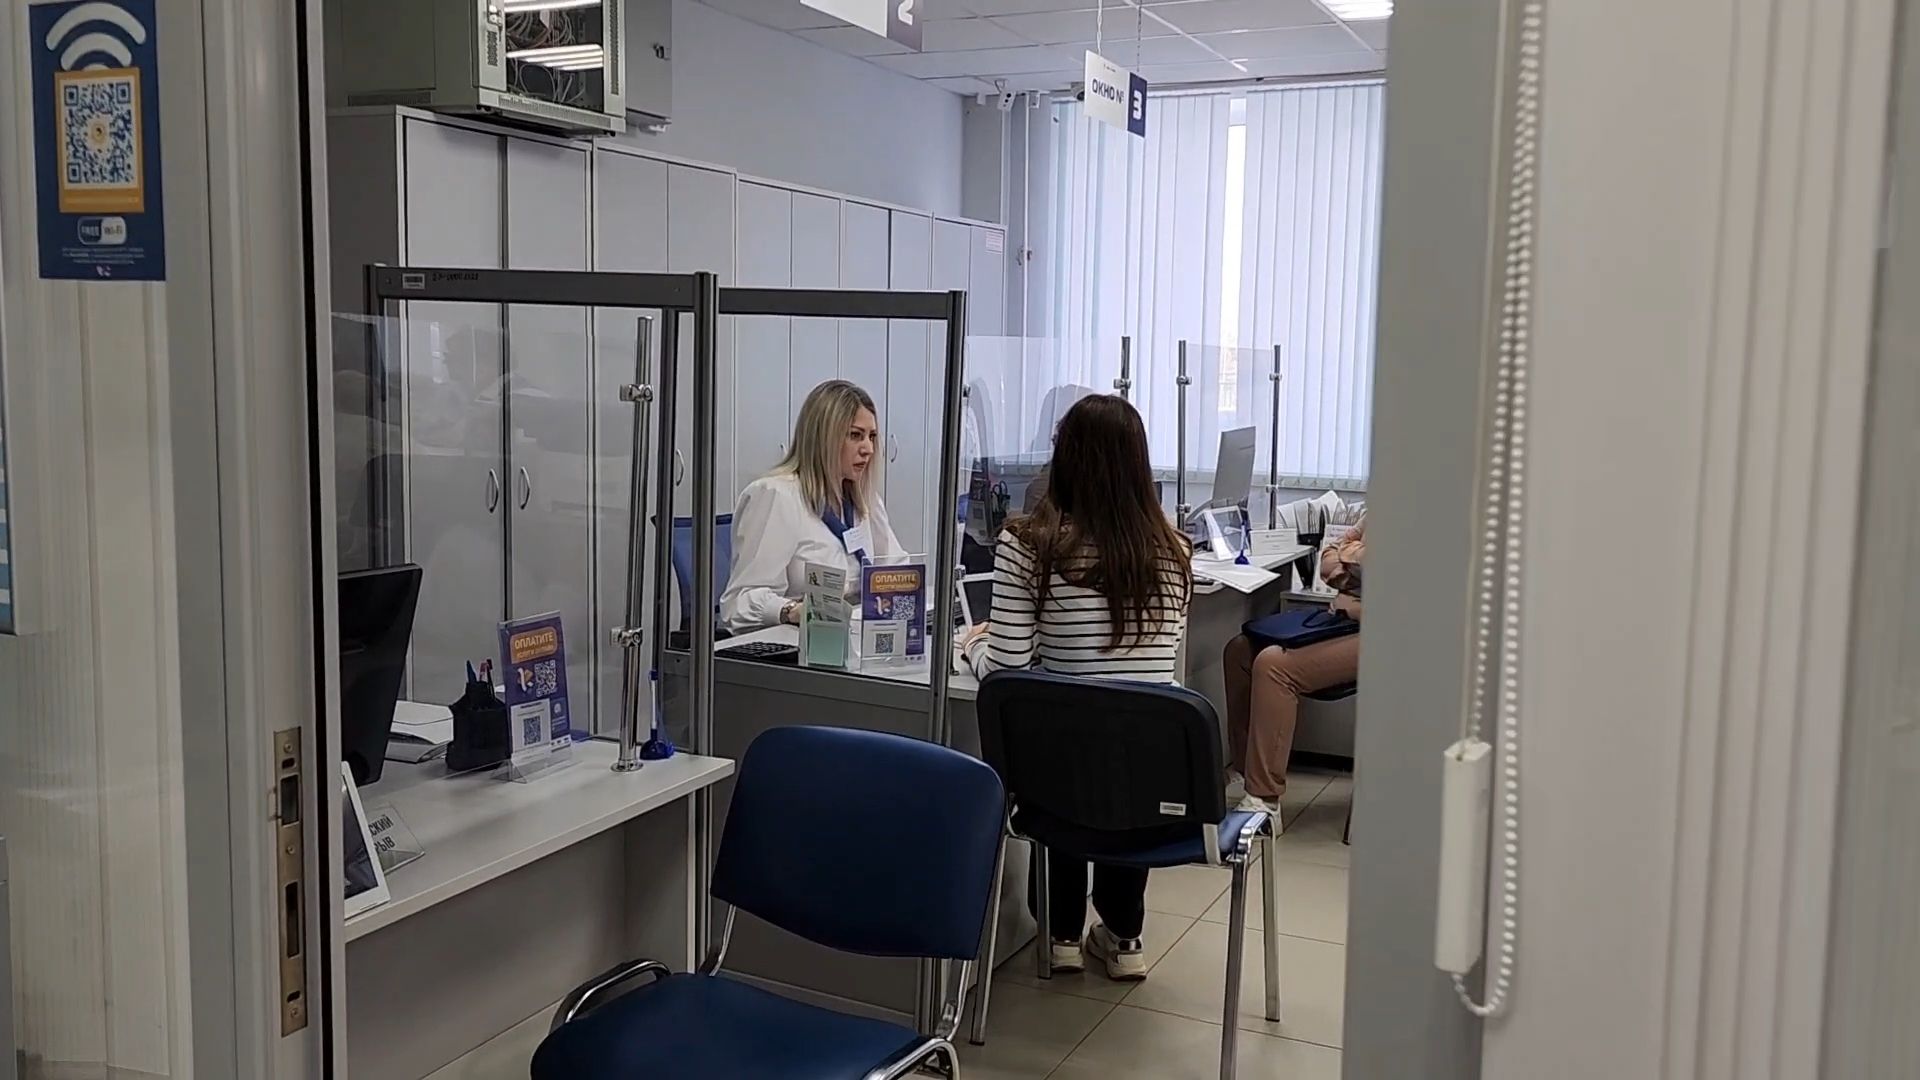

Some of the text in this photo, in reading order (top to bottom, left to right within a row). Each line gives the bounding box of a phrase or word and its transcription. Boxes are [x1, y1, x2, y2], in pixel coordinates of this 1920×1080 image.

[1092, 78, 1143, 121] ОКНО № 3
[875, 573, 917, 584] ОПЛАТИТЕ
[514, 631, 554, 650] ОПЛАТИТЕ
